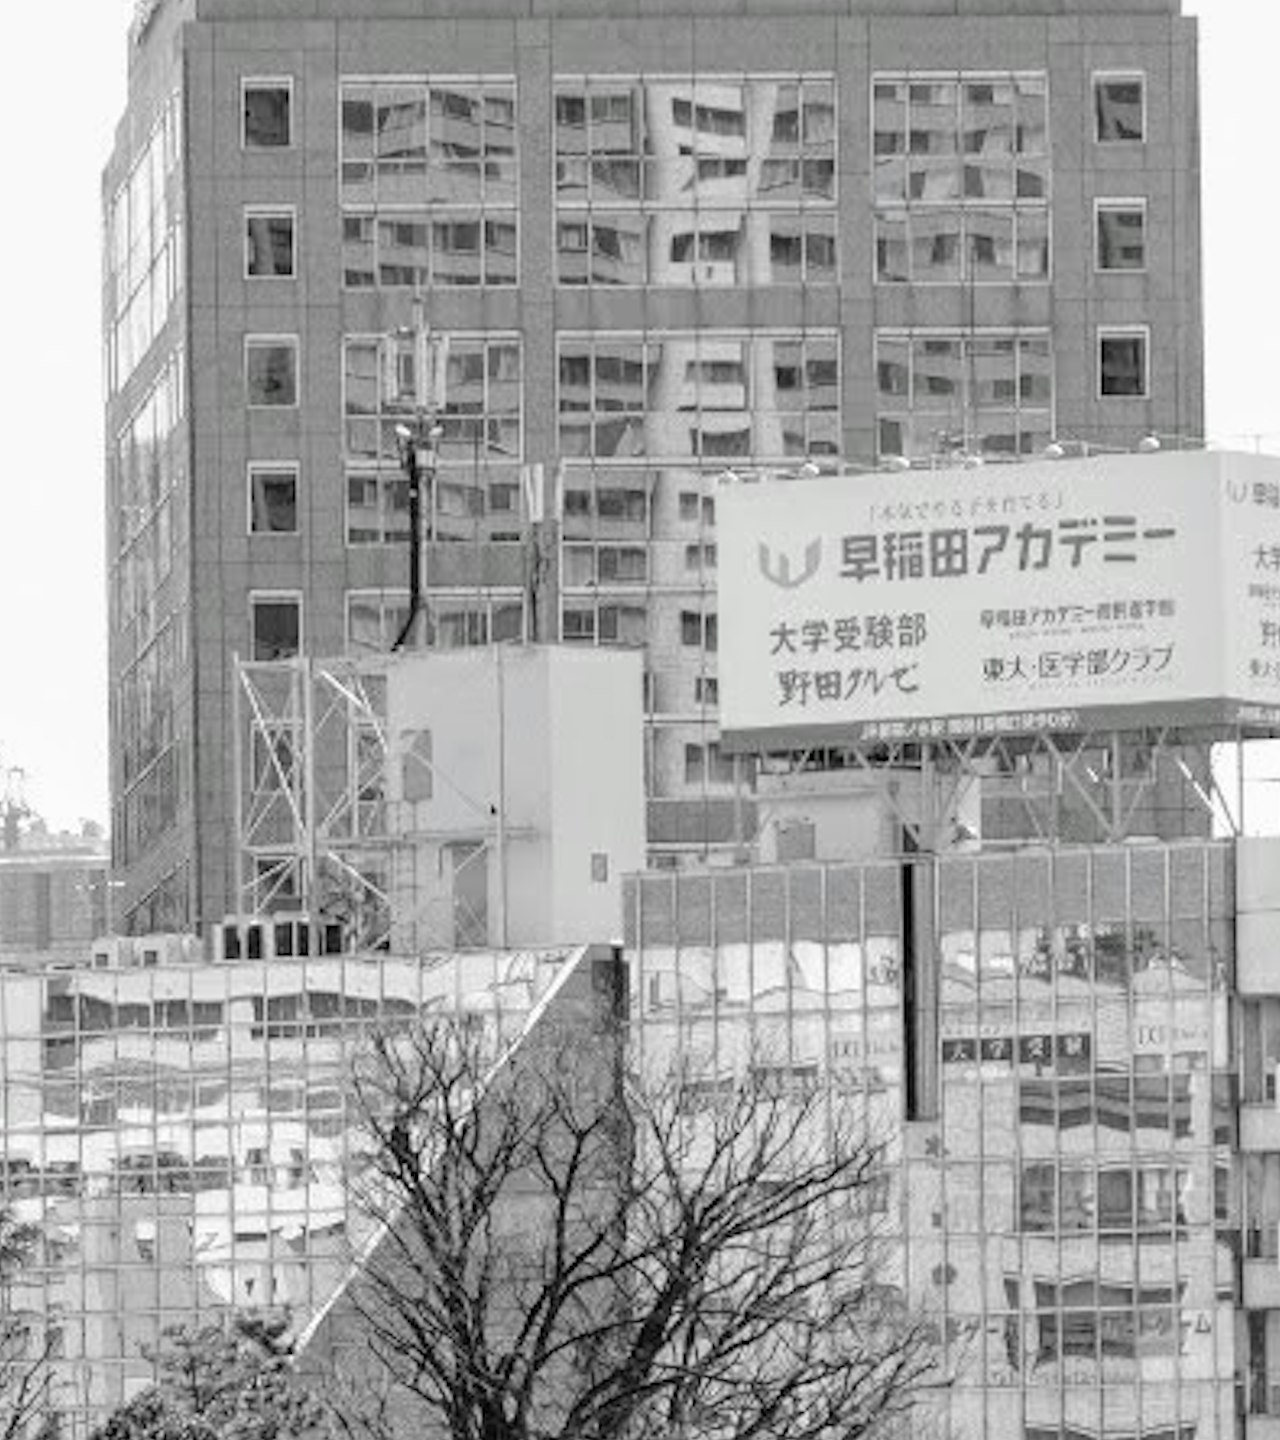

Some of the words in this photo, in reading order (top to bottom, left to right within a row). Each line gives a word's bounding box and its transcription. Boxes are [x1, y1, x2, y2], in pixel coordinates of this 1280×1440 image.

[840, 515, 1177, 582] 早稲田アカデミー
[769, 612, 926, 656] 大学受験部
